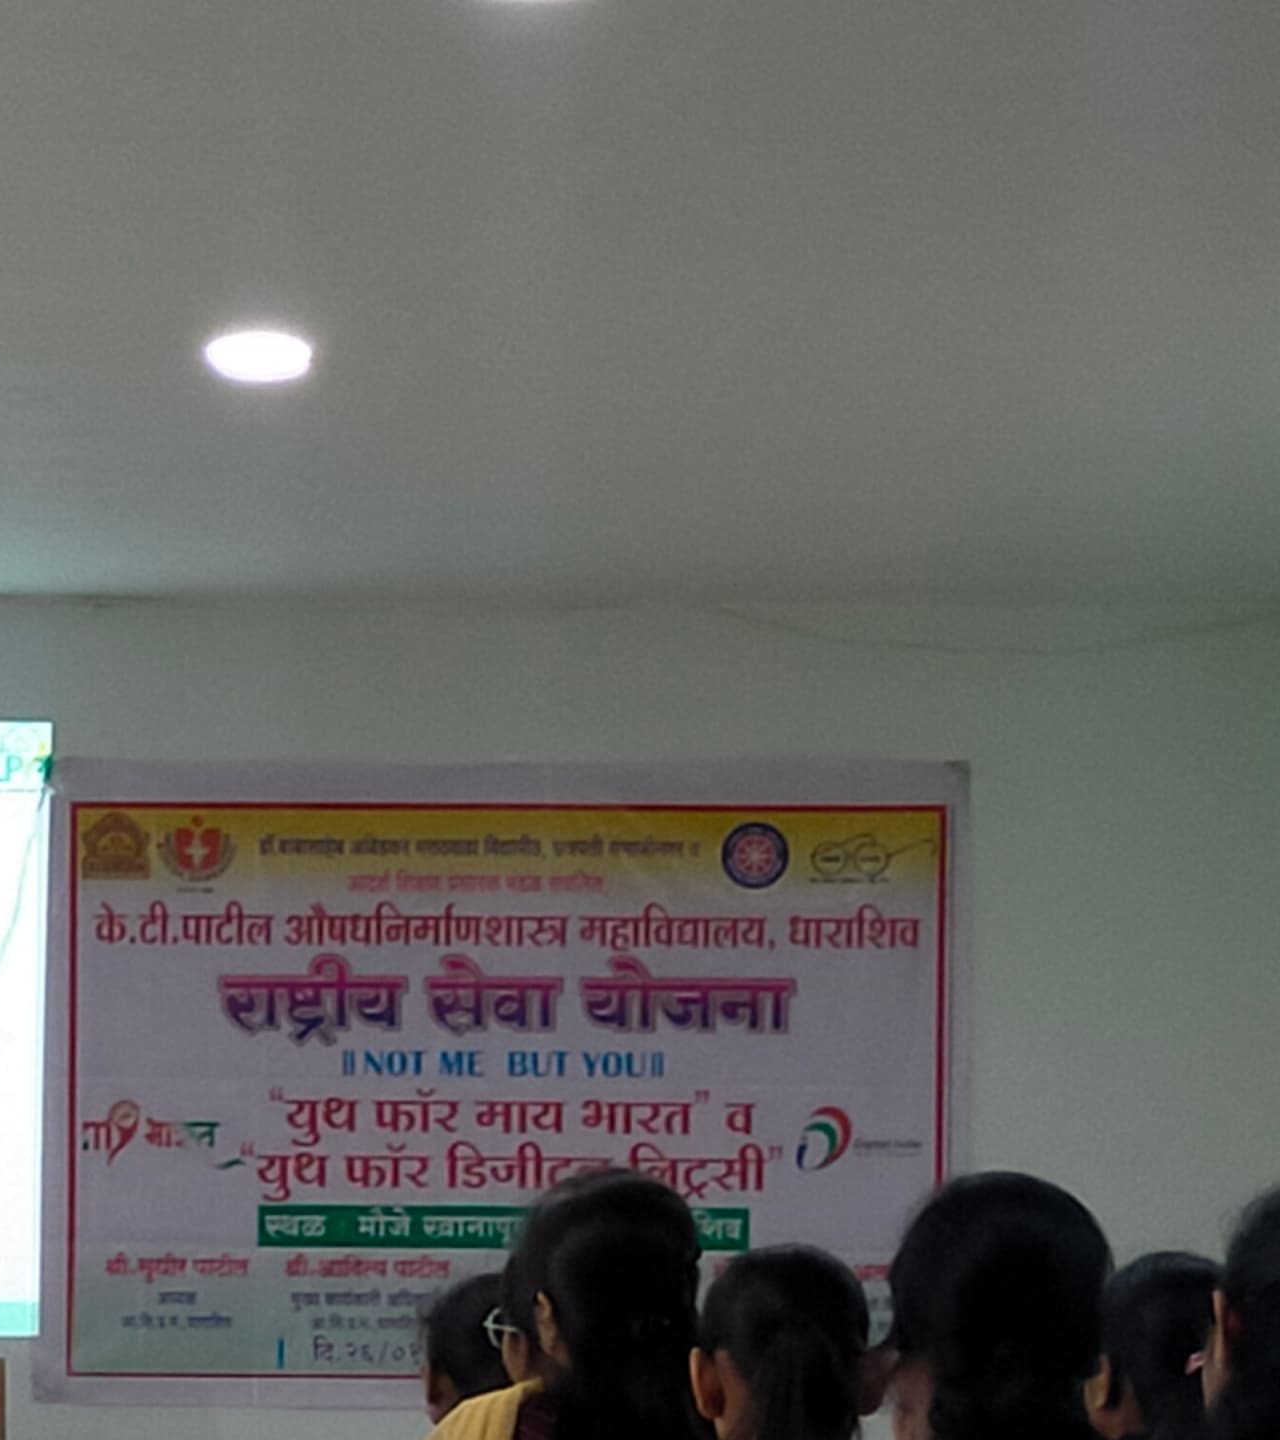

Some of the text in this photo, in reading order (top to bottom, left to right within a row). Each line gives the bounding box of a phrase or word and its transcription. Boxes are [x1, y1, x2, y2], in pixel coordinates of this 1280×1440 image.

[94, 900, 920, 952] के.टी.पाटील औषधनिर्माणशास्त्र महाविद्यालय, धाराशिव
[218, 953, 796, 1045] राष्ट्रीय सेवा योजना
[439, 1050, 485, 1077] ME
[507, 1051, 568, 1078] BUT
[373, 1089, 459, 1133] फॉर
[475, 1100, 562, 1134] माय
[724, 1102, 756, 1135] व
[345, 1143, 429, 1188] फॉर
